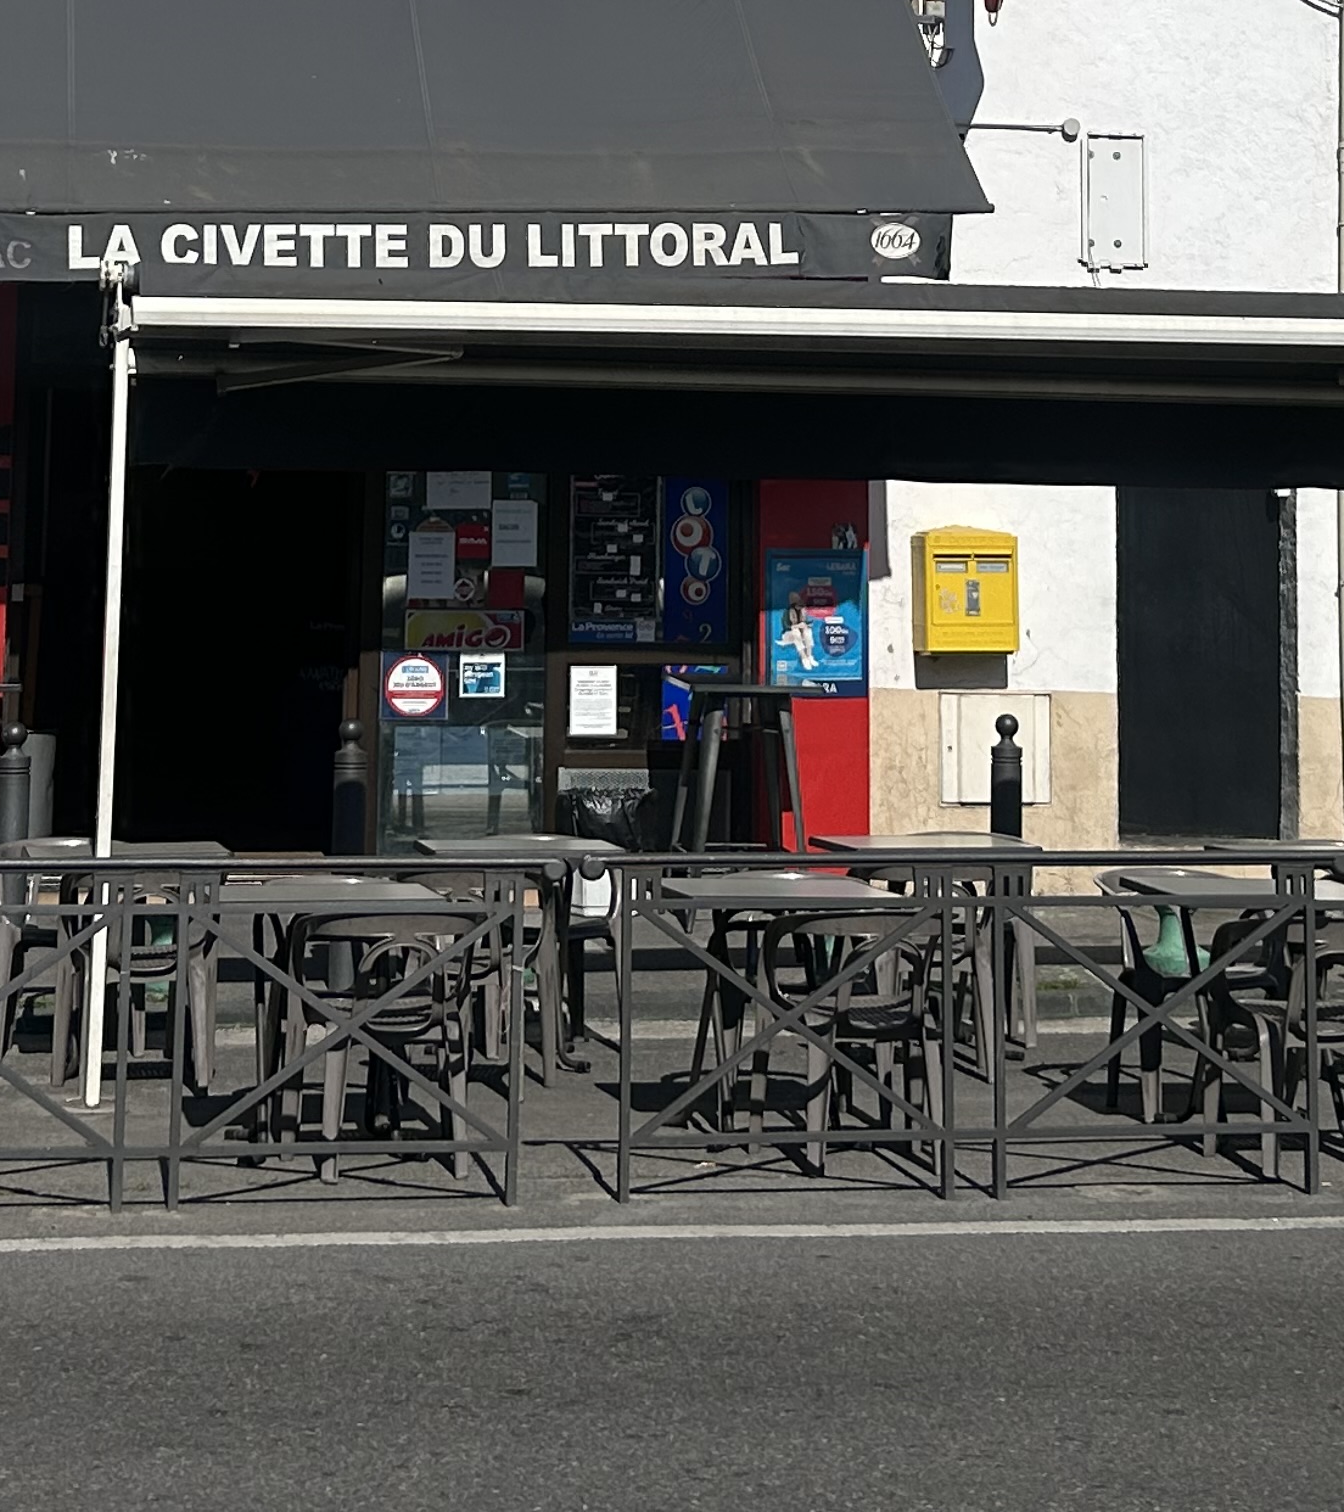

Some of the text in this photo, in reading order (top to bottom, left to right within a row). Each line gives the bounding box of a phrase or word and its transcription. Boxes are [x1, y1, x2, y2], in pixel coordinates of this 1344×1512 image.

[66, 222, 801, 269] LA CIVETTE DU LITTORAL
[875, 228, 917, 250] 1664
